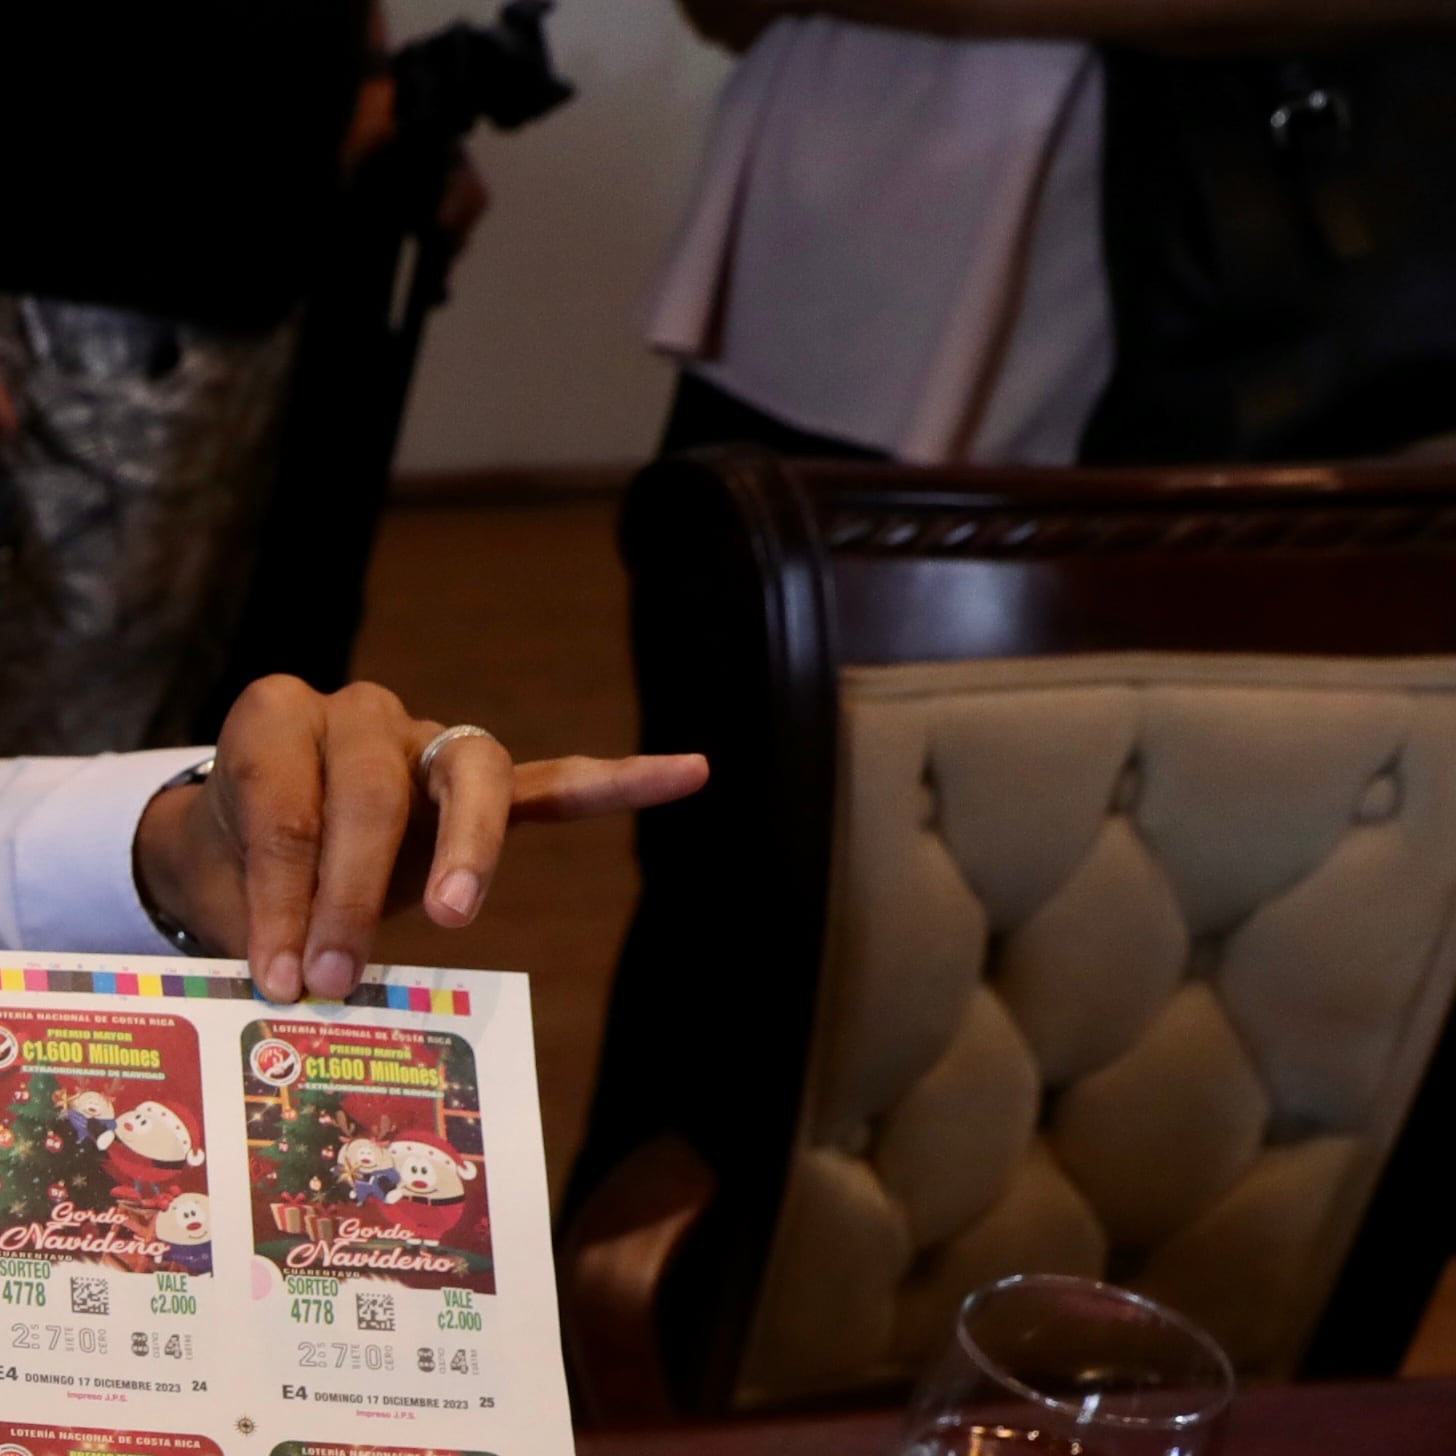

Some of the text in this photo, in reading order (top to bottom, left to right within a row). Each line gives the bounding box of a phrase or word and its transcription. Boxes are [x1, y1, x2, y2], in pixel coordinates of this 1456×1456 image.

[443, 1290, 474, 1309] VALE
[25, 1373, 74, 1385] DOMINGO
[78, 1377, 90, 1387] 17
[94, 1378, 152, 1391] DICIEMBRE
[155, 1383, 181, 1393] 2023
[192, 1381, 207, 1391] 24
